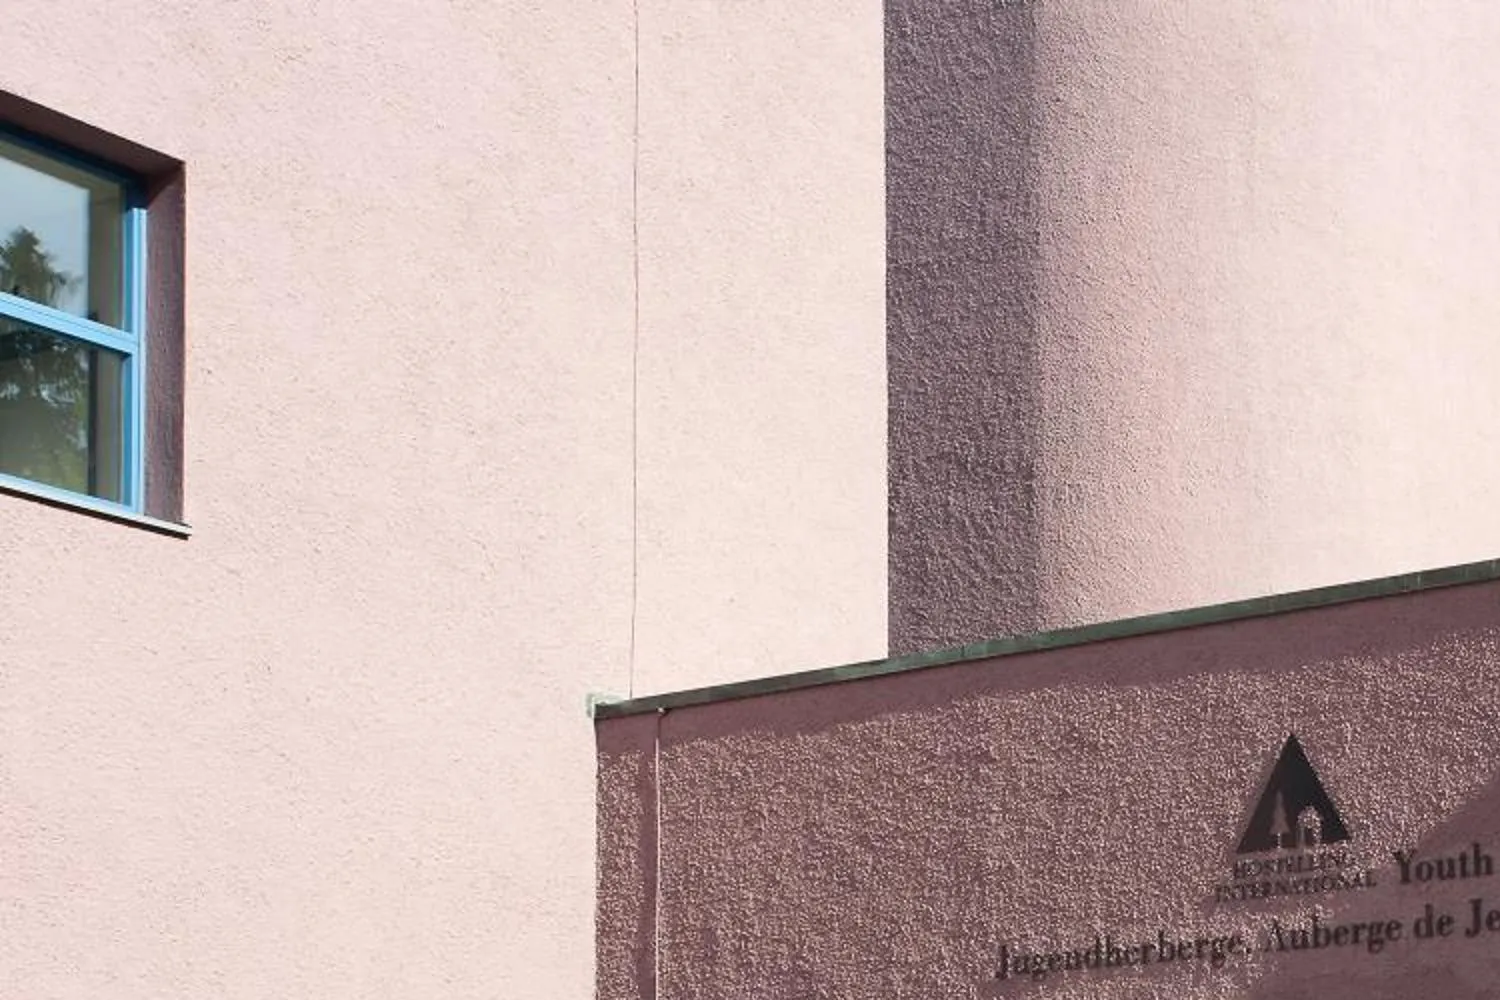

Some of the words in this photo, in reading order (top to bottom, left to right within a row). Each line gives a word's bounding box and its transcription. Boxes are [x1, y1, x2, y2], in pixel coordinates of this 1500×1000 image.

[1393, 843, 1494, 885] Youth
[1264, 913, 1402, 954] Auberge
[1414, 904, 1454, 938] de
